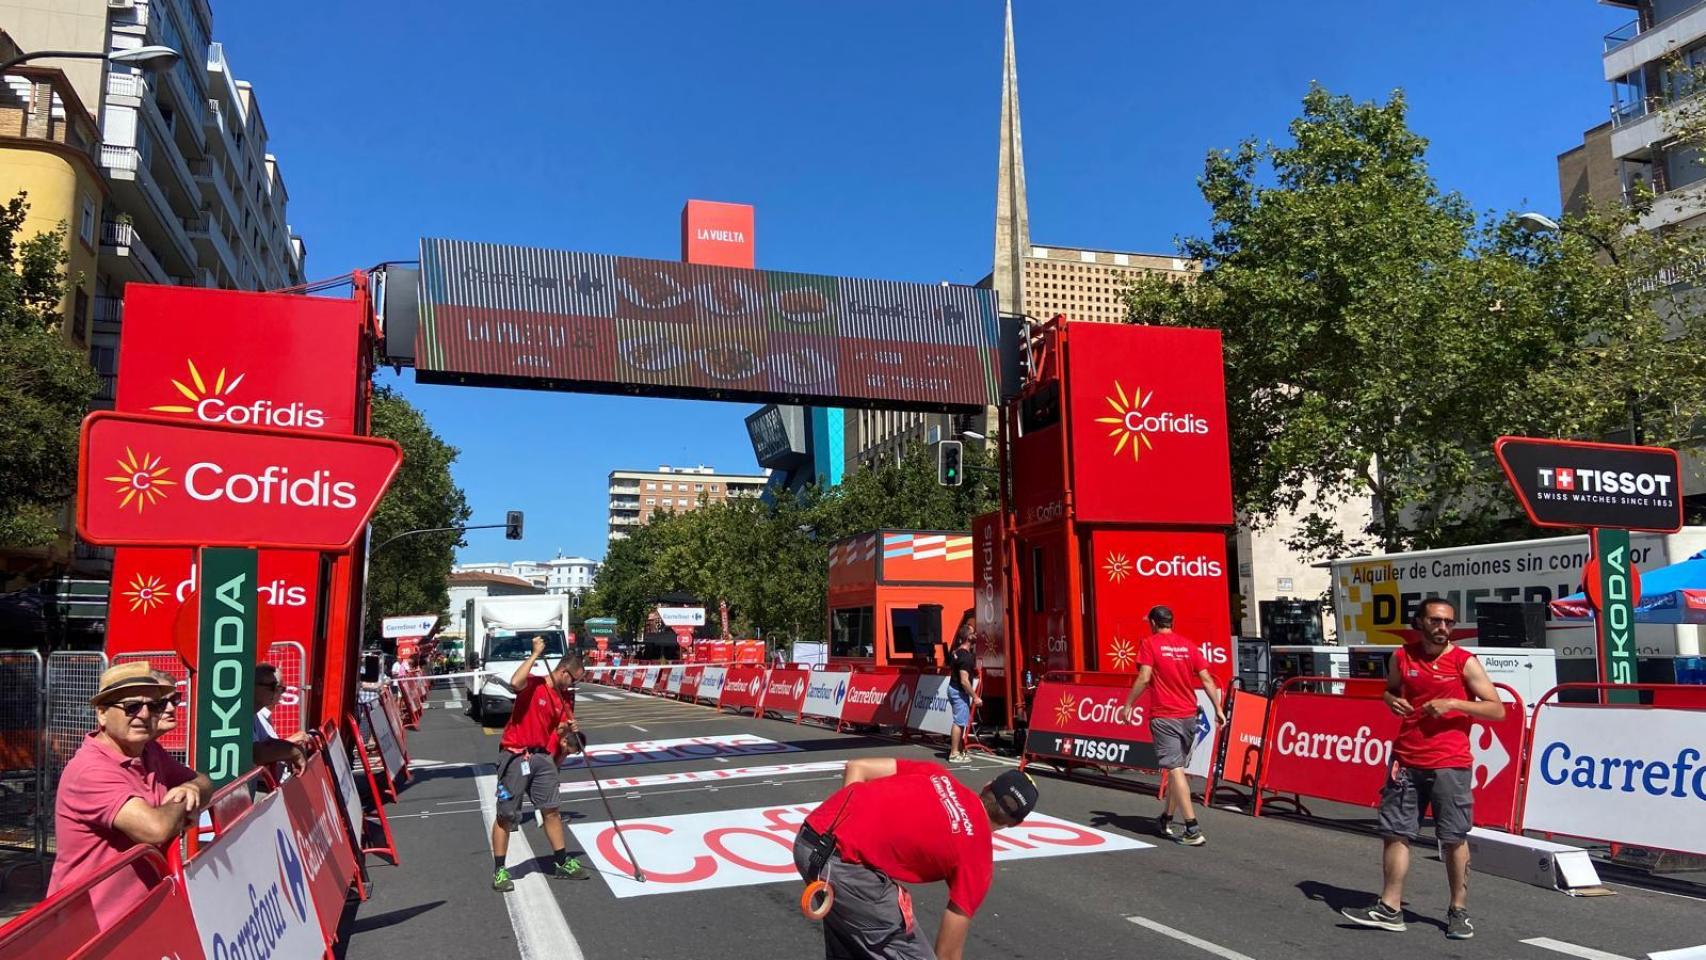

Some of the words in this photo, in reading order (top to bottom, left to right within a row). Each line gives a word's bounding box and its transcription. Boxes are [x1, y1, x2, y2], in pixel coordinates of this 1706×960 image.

[697, 228, 709, 240] LA
[710, 229, 744, 243] VUELTA
[197, 398, 326, 428] Cofidis
[1125, 411, 1209, 434] Cofidis
[184, 462, 358, 509] Cofidis
[1576, 468, 1671, 497] TISSOT
[1537, 492, 1568, 501] SWISS
[1573, 494, 1617, 504] WATCHES
[1621, 497, 1649, 506] SINCE
[984, 523, 995, 624] Cofidis
[1136, 555, 1222, 577] Cofidis
[1353, 563, 1405, 585] Alquiler
[1409, 562, 1427, 579] de
[1431, 557, 1511, 578] Camiones
[1517, 553, 1543, 573] sin
[847, 686, 888, 704] Carrefour
[914, 690, 949, 712] Carrefour
